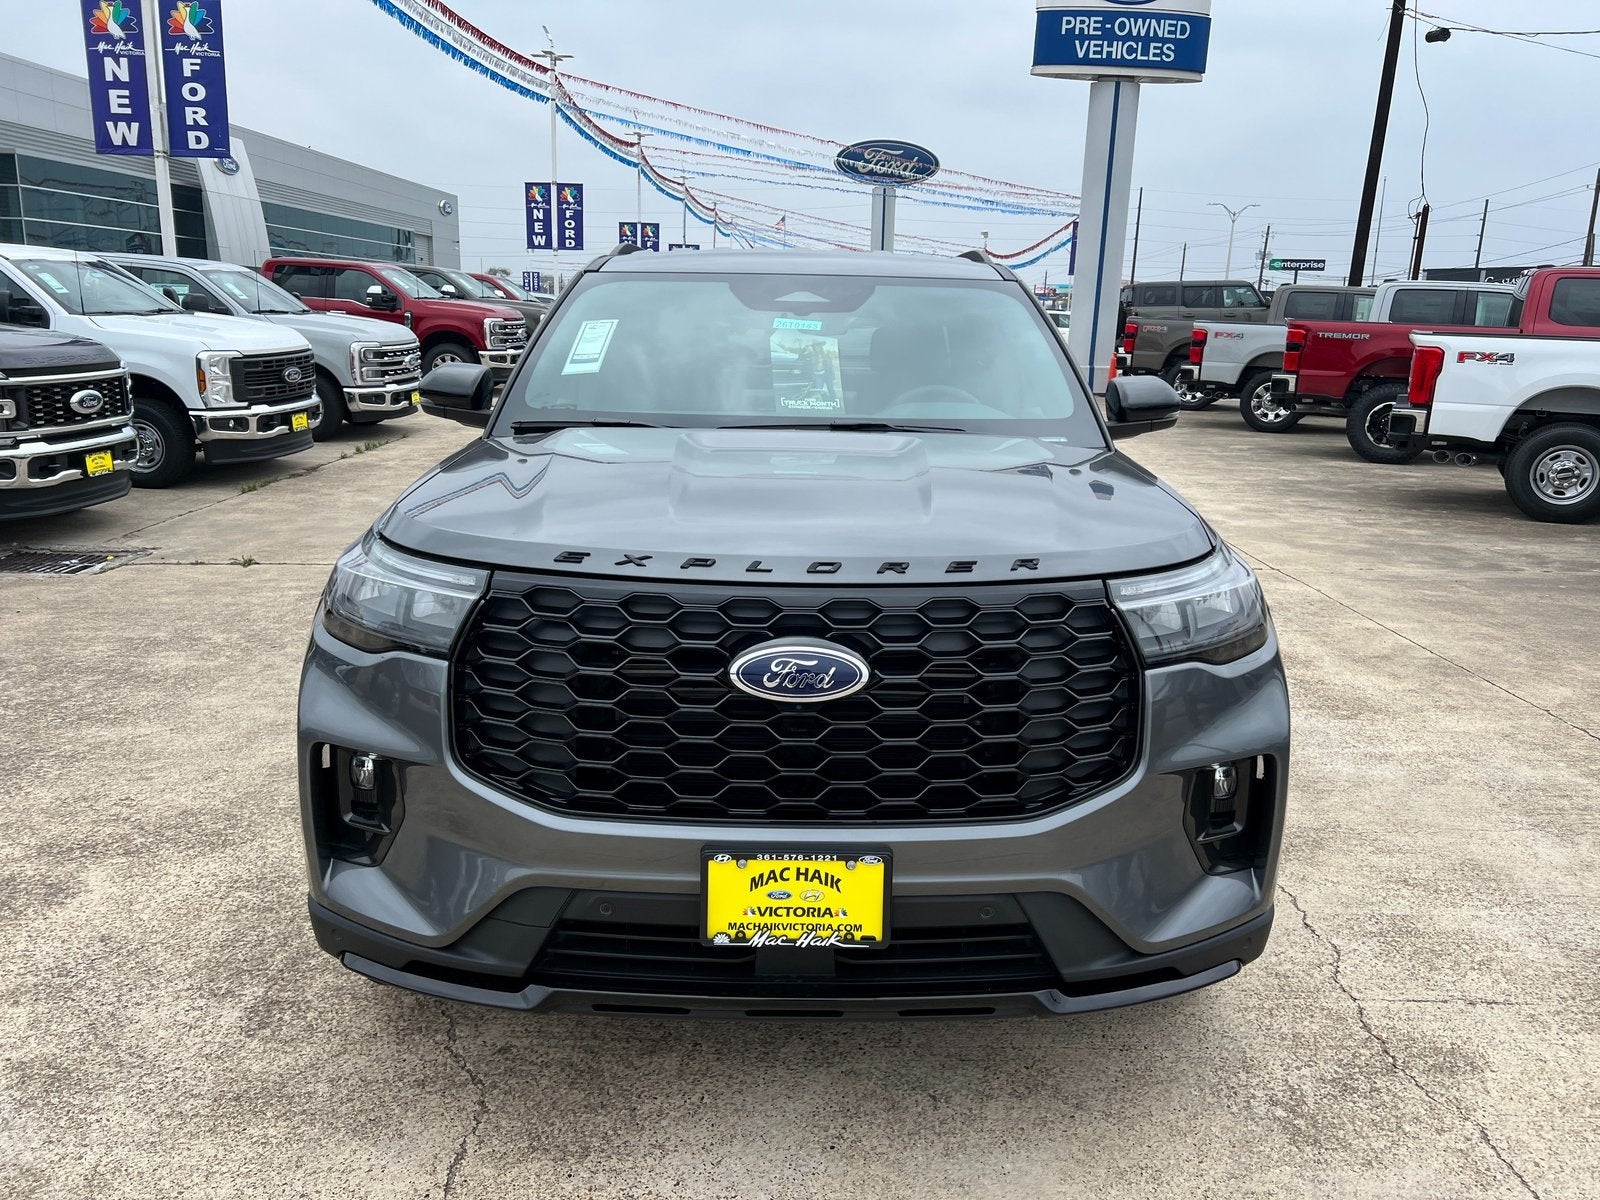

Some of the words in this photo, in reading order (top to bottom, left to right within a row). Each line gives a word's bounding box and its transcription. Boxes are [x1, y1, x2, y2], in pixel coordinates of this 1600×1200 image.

[1060, 16, 1191, 40] PRE-OWNED
[1074, 40, 1175, 63] VEHICLES
[103, 57, 139, 147] NEW
[181, 58, 210, 150] FORD
[858, 147, 919, 174] Ford
[532, 208, 546, 246] NEW
[564, 210, 576, 248] FORD
[1271, 260, 1325, 270] enterprise
[1214, 331, 1244, 340] FX4
[1317, 331, 1370, 340] TREMOR
[1456, 351, 1515, 364] FX4
[553, 550, 1040, 575] EXPLORER
[763, 657, 836, 690] Ford
[756, 853, 838, 862] 361-576-1221
[749, 867, 791, 893] MAC
[795, 866, 842, 894] HAIK
[769, 891, 790, 900] Ford
[757, 906, 834, 919] VICTORIA
[727, 921, 863, 933] MACHAIKVICTORIA.COM
[749, 930, 792, 948] Mac
[795, 930, 845, 948] Haik
